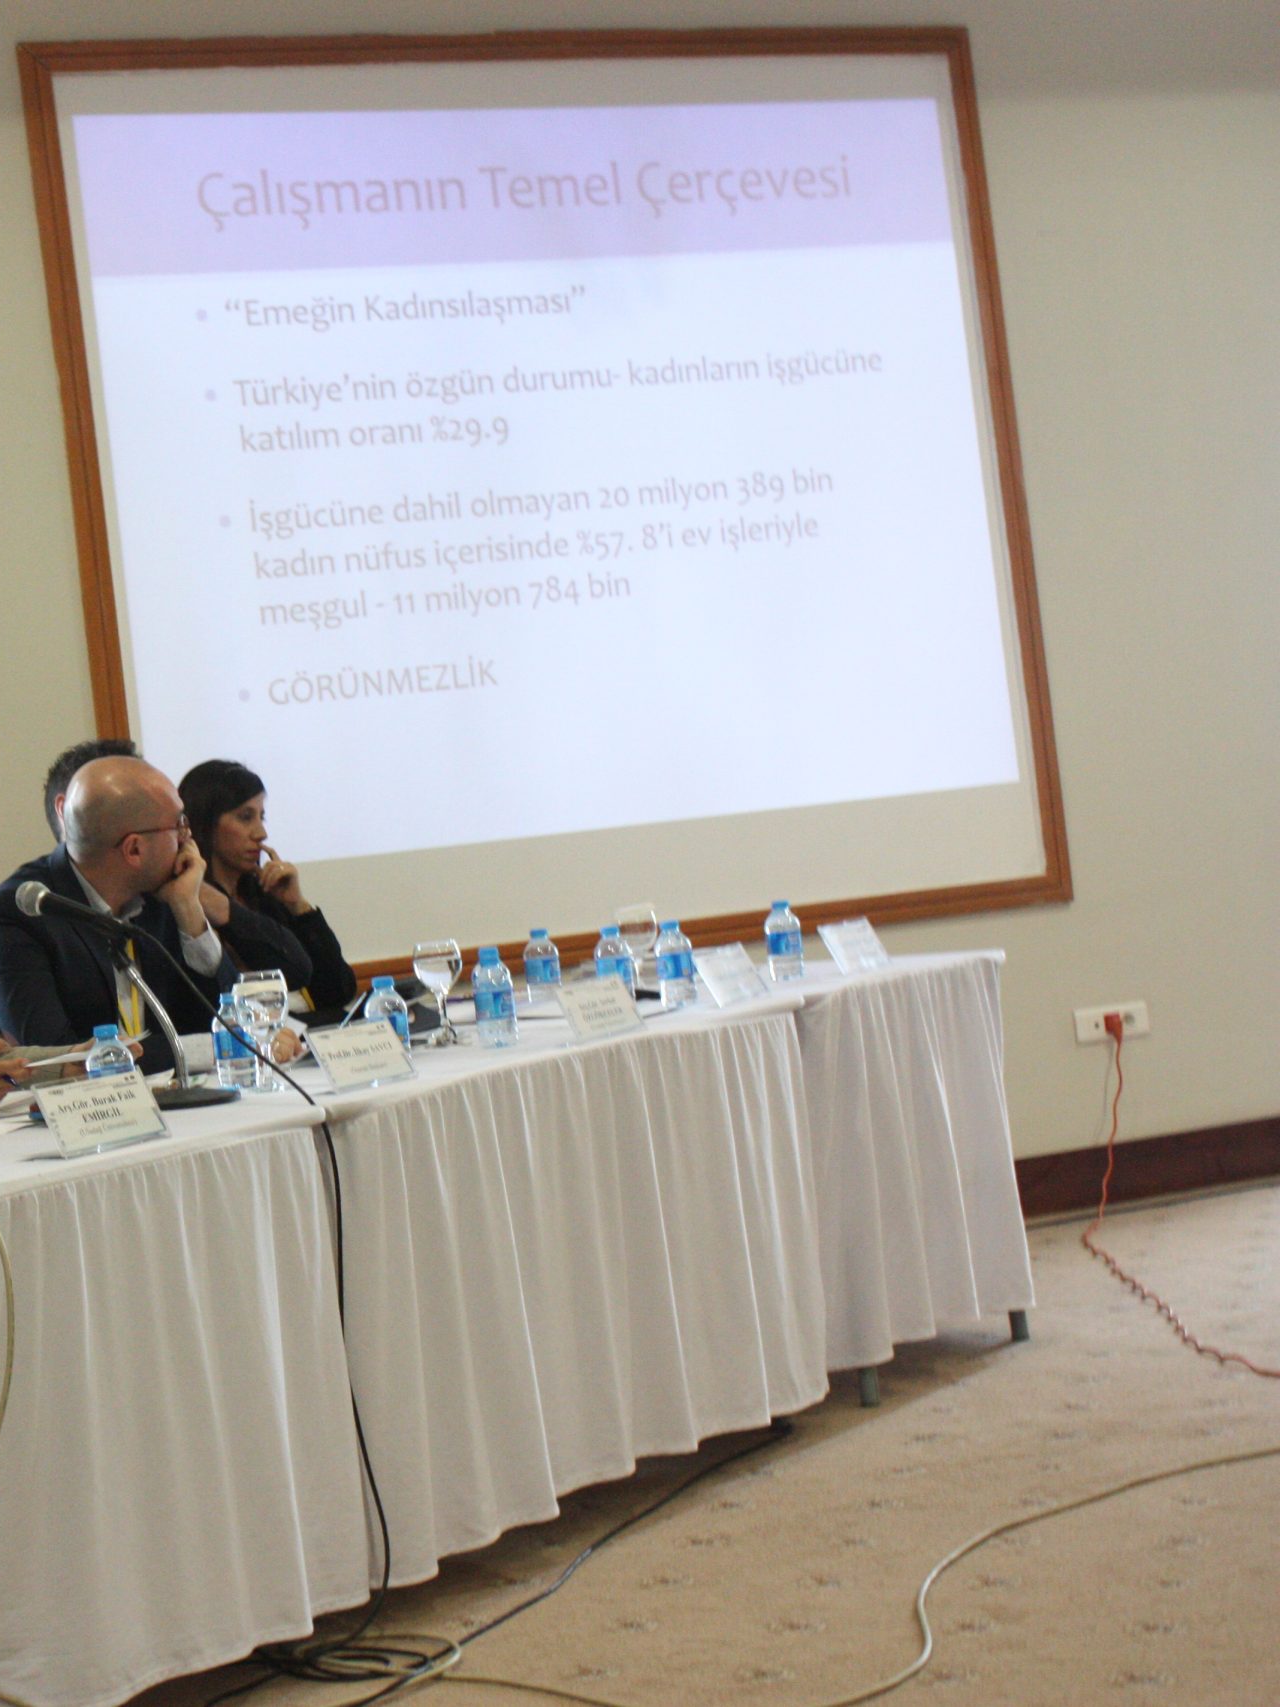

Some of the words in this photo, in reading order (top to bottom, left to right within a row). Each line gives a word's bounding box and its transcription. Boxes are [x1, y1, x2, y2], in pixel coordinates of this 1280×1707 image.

[196, 169, 468, 232] Çalışmanın
[478, 161, 622, 210] Temel
[636, 155, 853, 219] Çerçevesi
[404, 369, 496, 406] özgün
[501, 365, 622, 394] durumu-
[626, 355, 761, 386] kadınların
[766, 349, 883, 386] işgücüne
[238, 420, 341, 453] katılım
[347, 423, 424, 447] oranı
[429, 414, 511, 448] %29.9
[248, 498, 385, 542] İşgücüne
[392, 490, 463, 524] dahil
[469, 488, 591, 521] olmayan
[598, 486, 631, 510] 20
[637, 477, 729, 512] milyon
[736, 471, 786, 506] 389
[791, 467, 834, 495] bin
[253, 547, 336, 580] kadın
[344, 541, 427, 573] nüfus
[434, 531, 569, 575] içerisinde
[680, 527, 712, 548] ev
[719, 511, 819, 552] işleriyle
[259, 589, 368, 631] meşgul
[393, 592, 416, 615] 11
[424, 581, 522, 618] milyon
[528, 576, 581, 610] 784
[586, 571, 632, 600] bin
[267, 655, 499, 706] GÖRÜNMEZLİK
[92, 1094, 118, 1106] Burak
